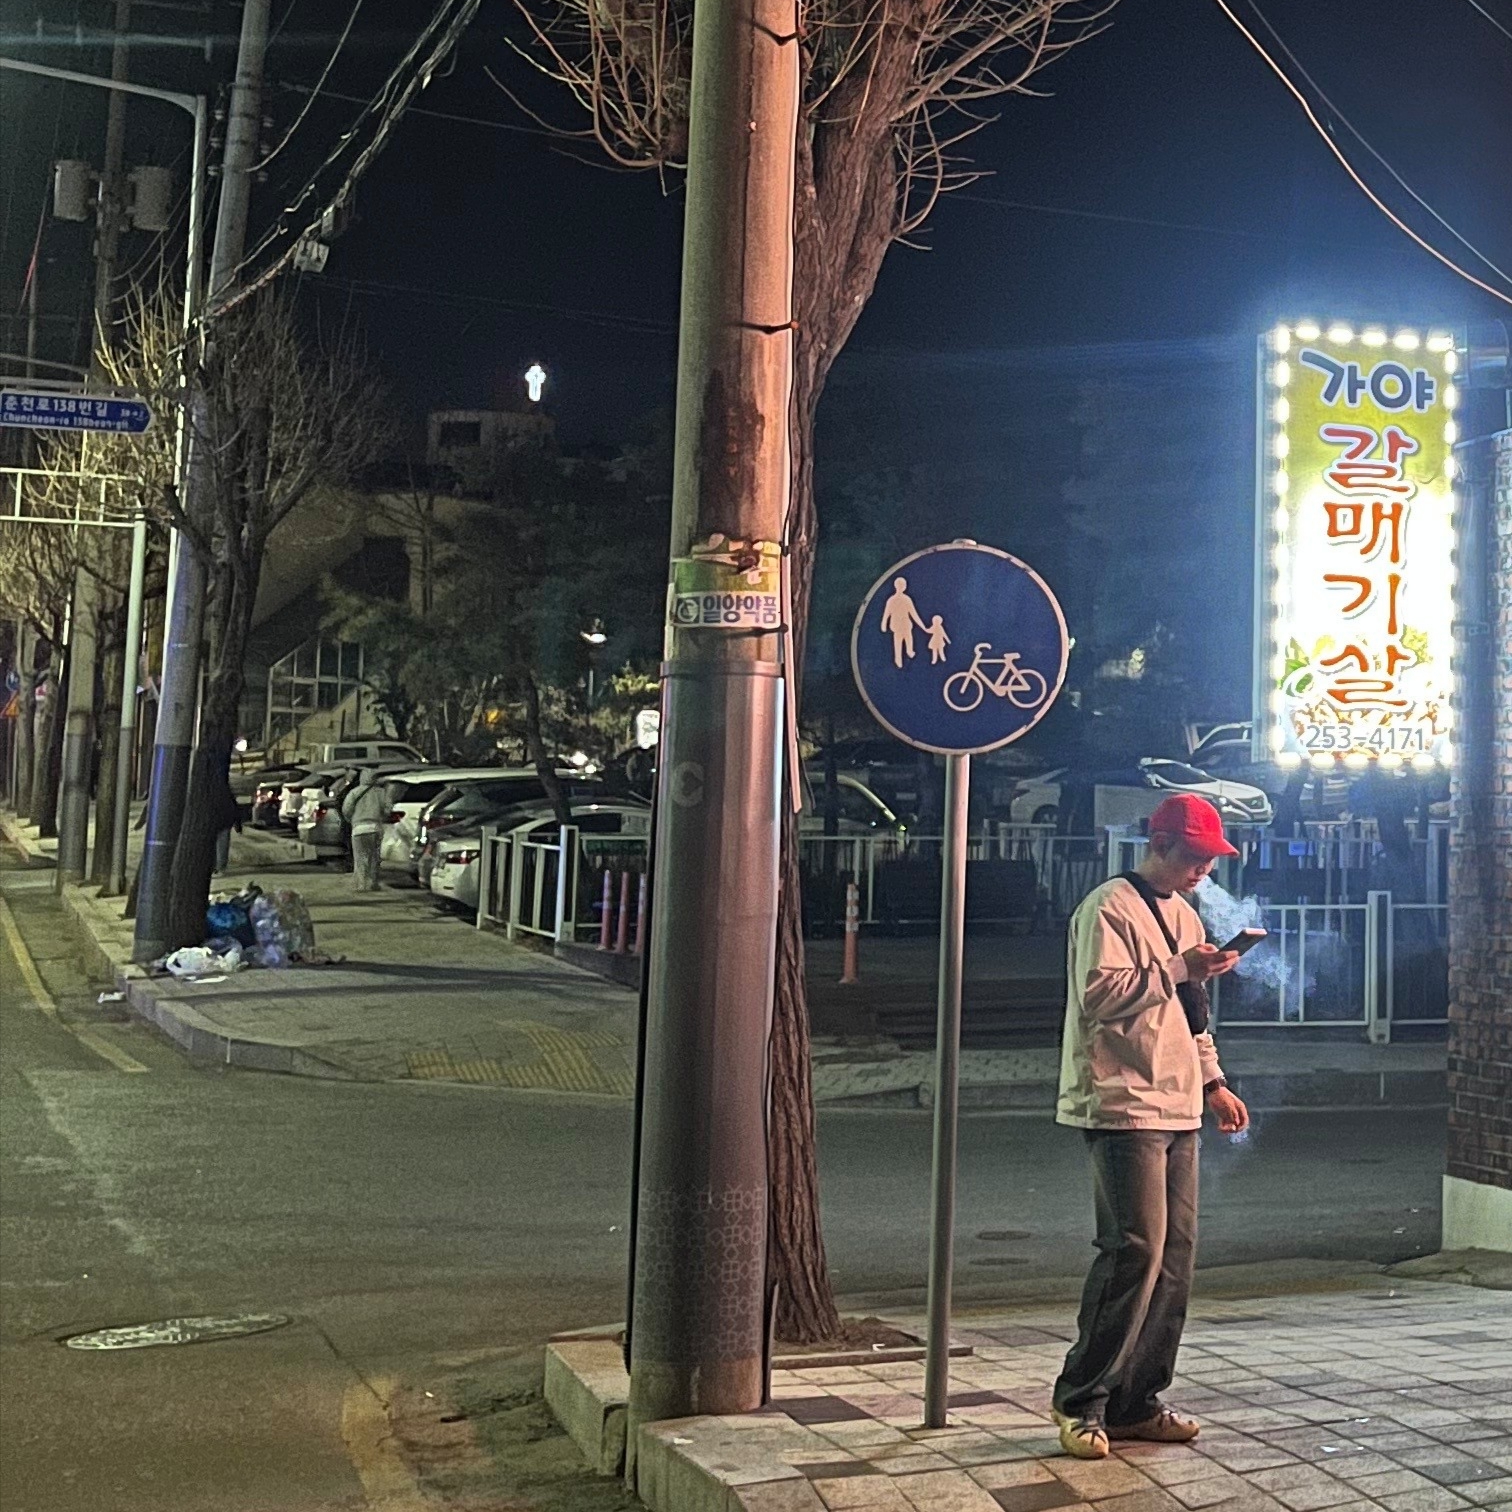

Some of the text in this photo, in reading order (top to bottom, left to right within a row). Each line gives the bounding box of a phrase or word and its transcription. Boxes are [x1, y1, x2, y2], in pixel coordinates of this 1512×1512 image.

[1301, 349, 1435, 412] 가야
[1319, 426, 1418, 707] 갈매기살
[703, 595, 776, 624] 일양약품
[1306, 724, 1424, 751] 253-4171
